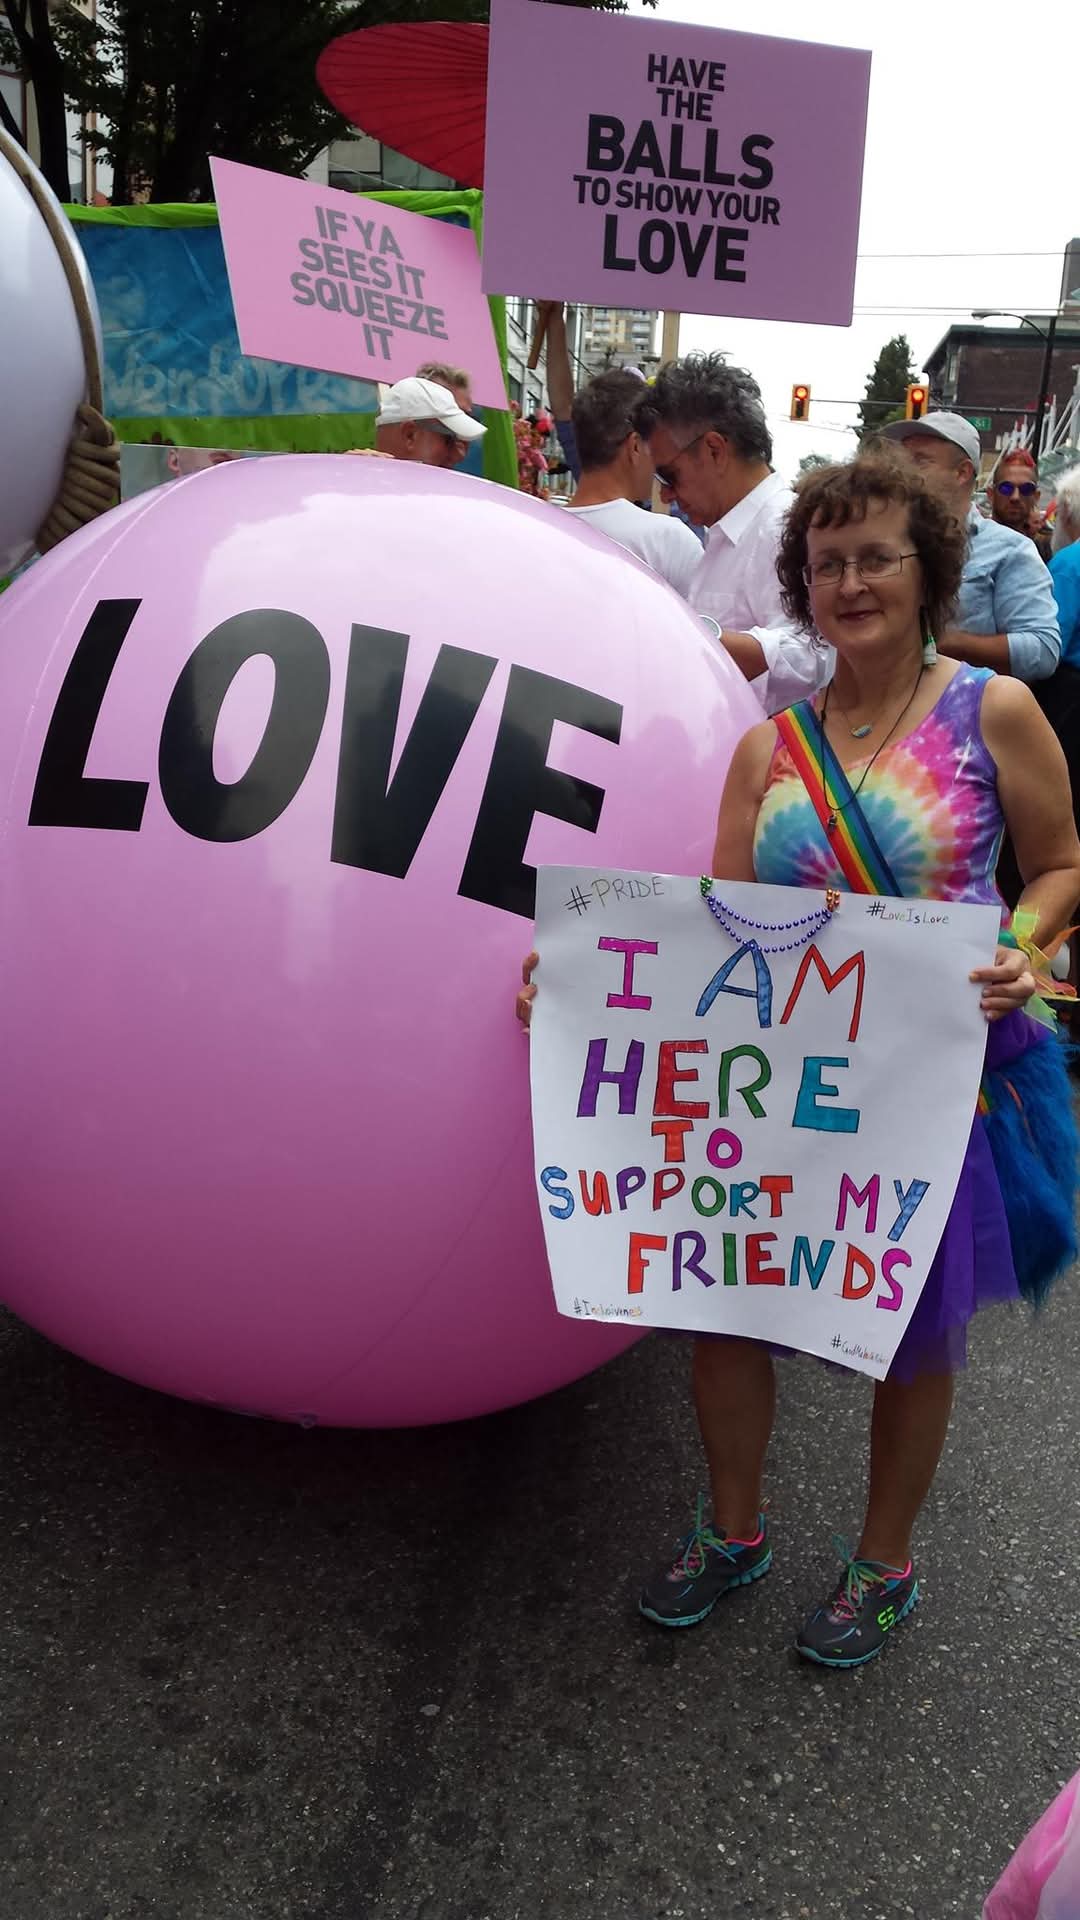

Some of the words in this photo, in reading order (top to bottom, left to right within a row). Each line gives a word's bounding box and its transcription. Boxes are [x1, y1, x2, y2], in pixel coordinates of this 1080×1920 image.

[647, 53, 726, 92] HAVE
[656, 87, 713, 122] THE
[586, 113, 775, 189] BALLS
[573, 175, 611, 205] TO
[616, 180, 703, 216] SHOW
[706, 191, 780, 226] YOUR
[315, 206, 347, 241] IF
[352, 215, 404, 260] YA
[603, 214, 748, 283] LOVE
[298, 238, 392, 289] SEES
[396, 263, 425, 299] IT
[290, 272, 449, 340] SQUEEZE
[362, 323, 393, 360] IT
[28, 598, 624, 921] LOVE
[564, 876, 664, 916] #PRIDE
[598, 936, 658, 1010] I
[695, 938, 865, 1042] AM
[576, 1038, 860, 1132] HERE
[651, 1119, 743, 1169] TO
[540, 1165, 793, 1220] SUPPORT
[835, 1172, 930, 1241] MY
[627, 1230, 912, 1311] FRIENDS
